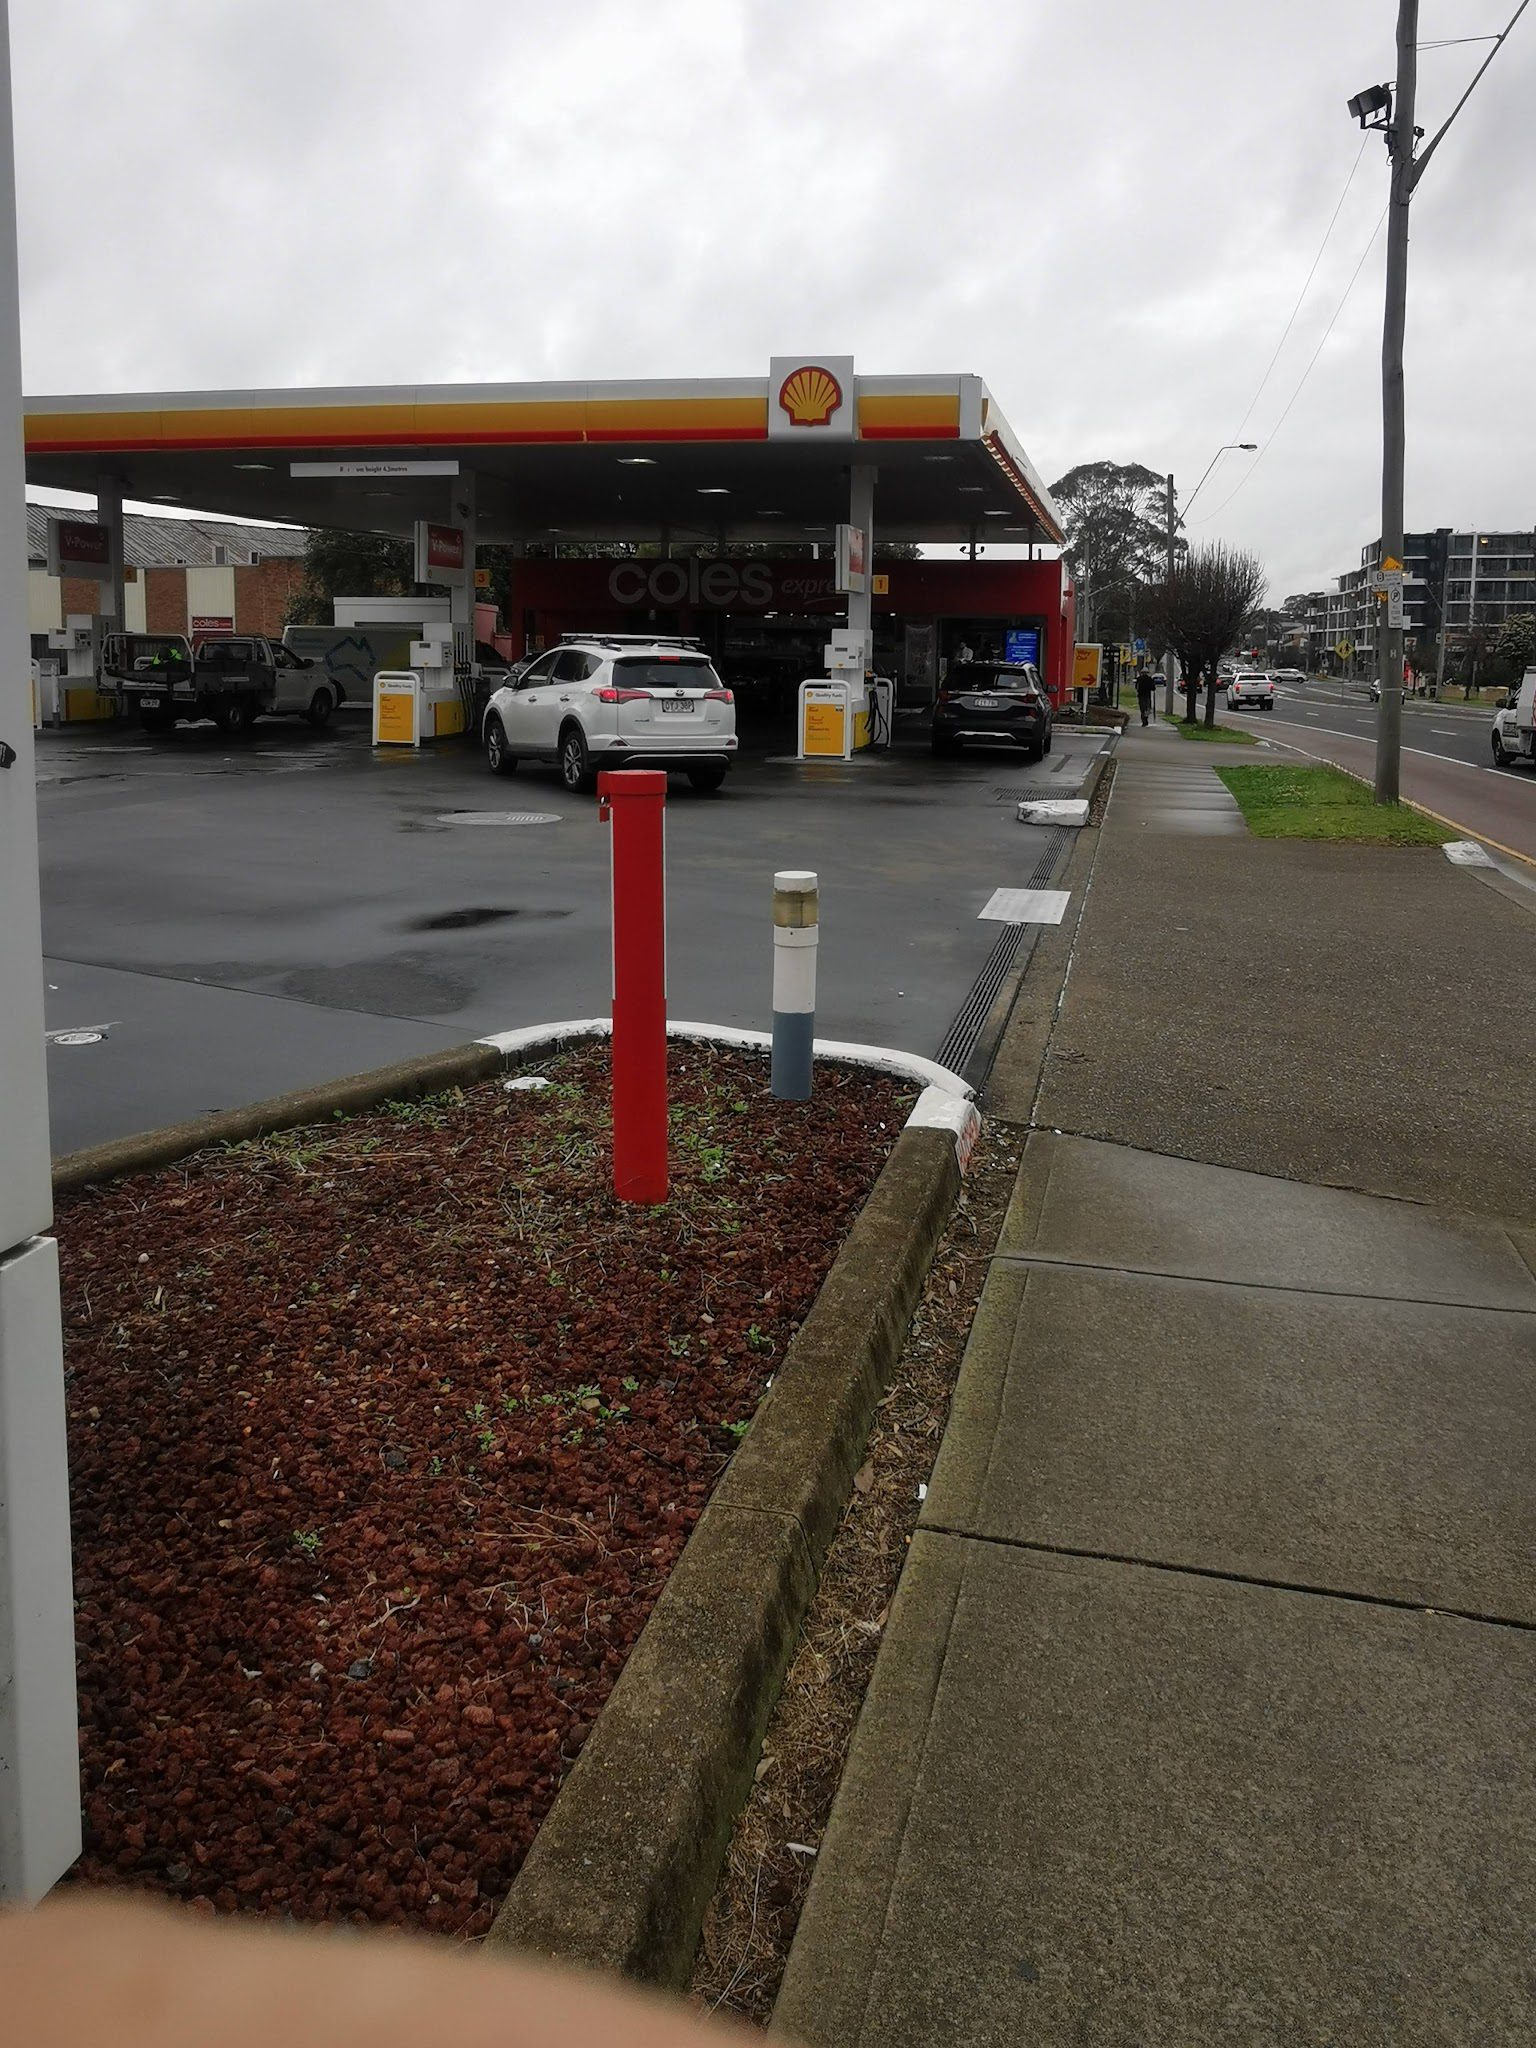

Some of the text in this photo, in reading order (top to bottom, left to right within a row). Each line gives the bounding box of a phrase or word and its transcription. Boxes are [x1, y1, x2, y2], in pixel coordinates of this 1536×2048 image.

[477, 573, 486, 583] 3
[608, 557, 835, 606] coles expre
[193, 618, 220, 628] coles
